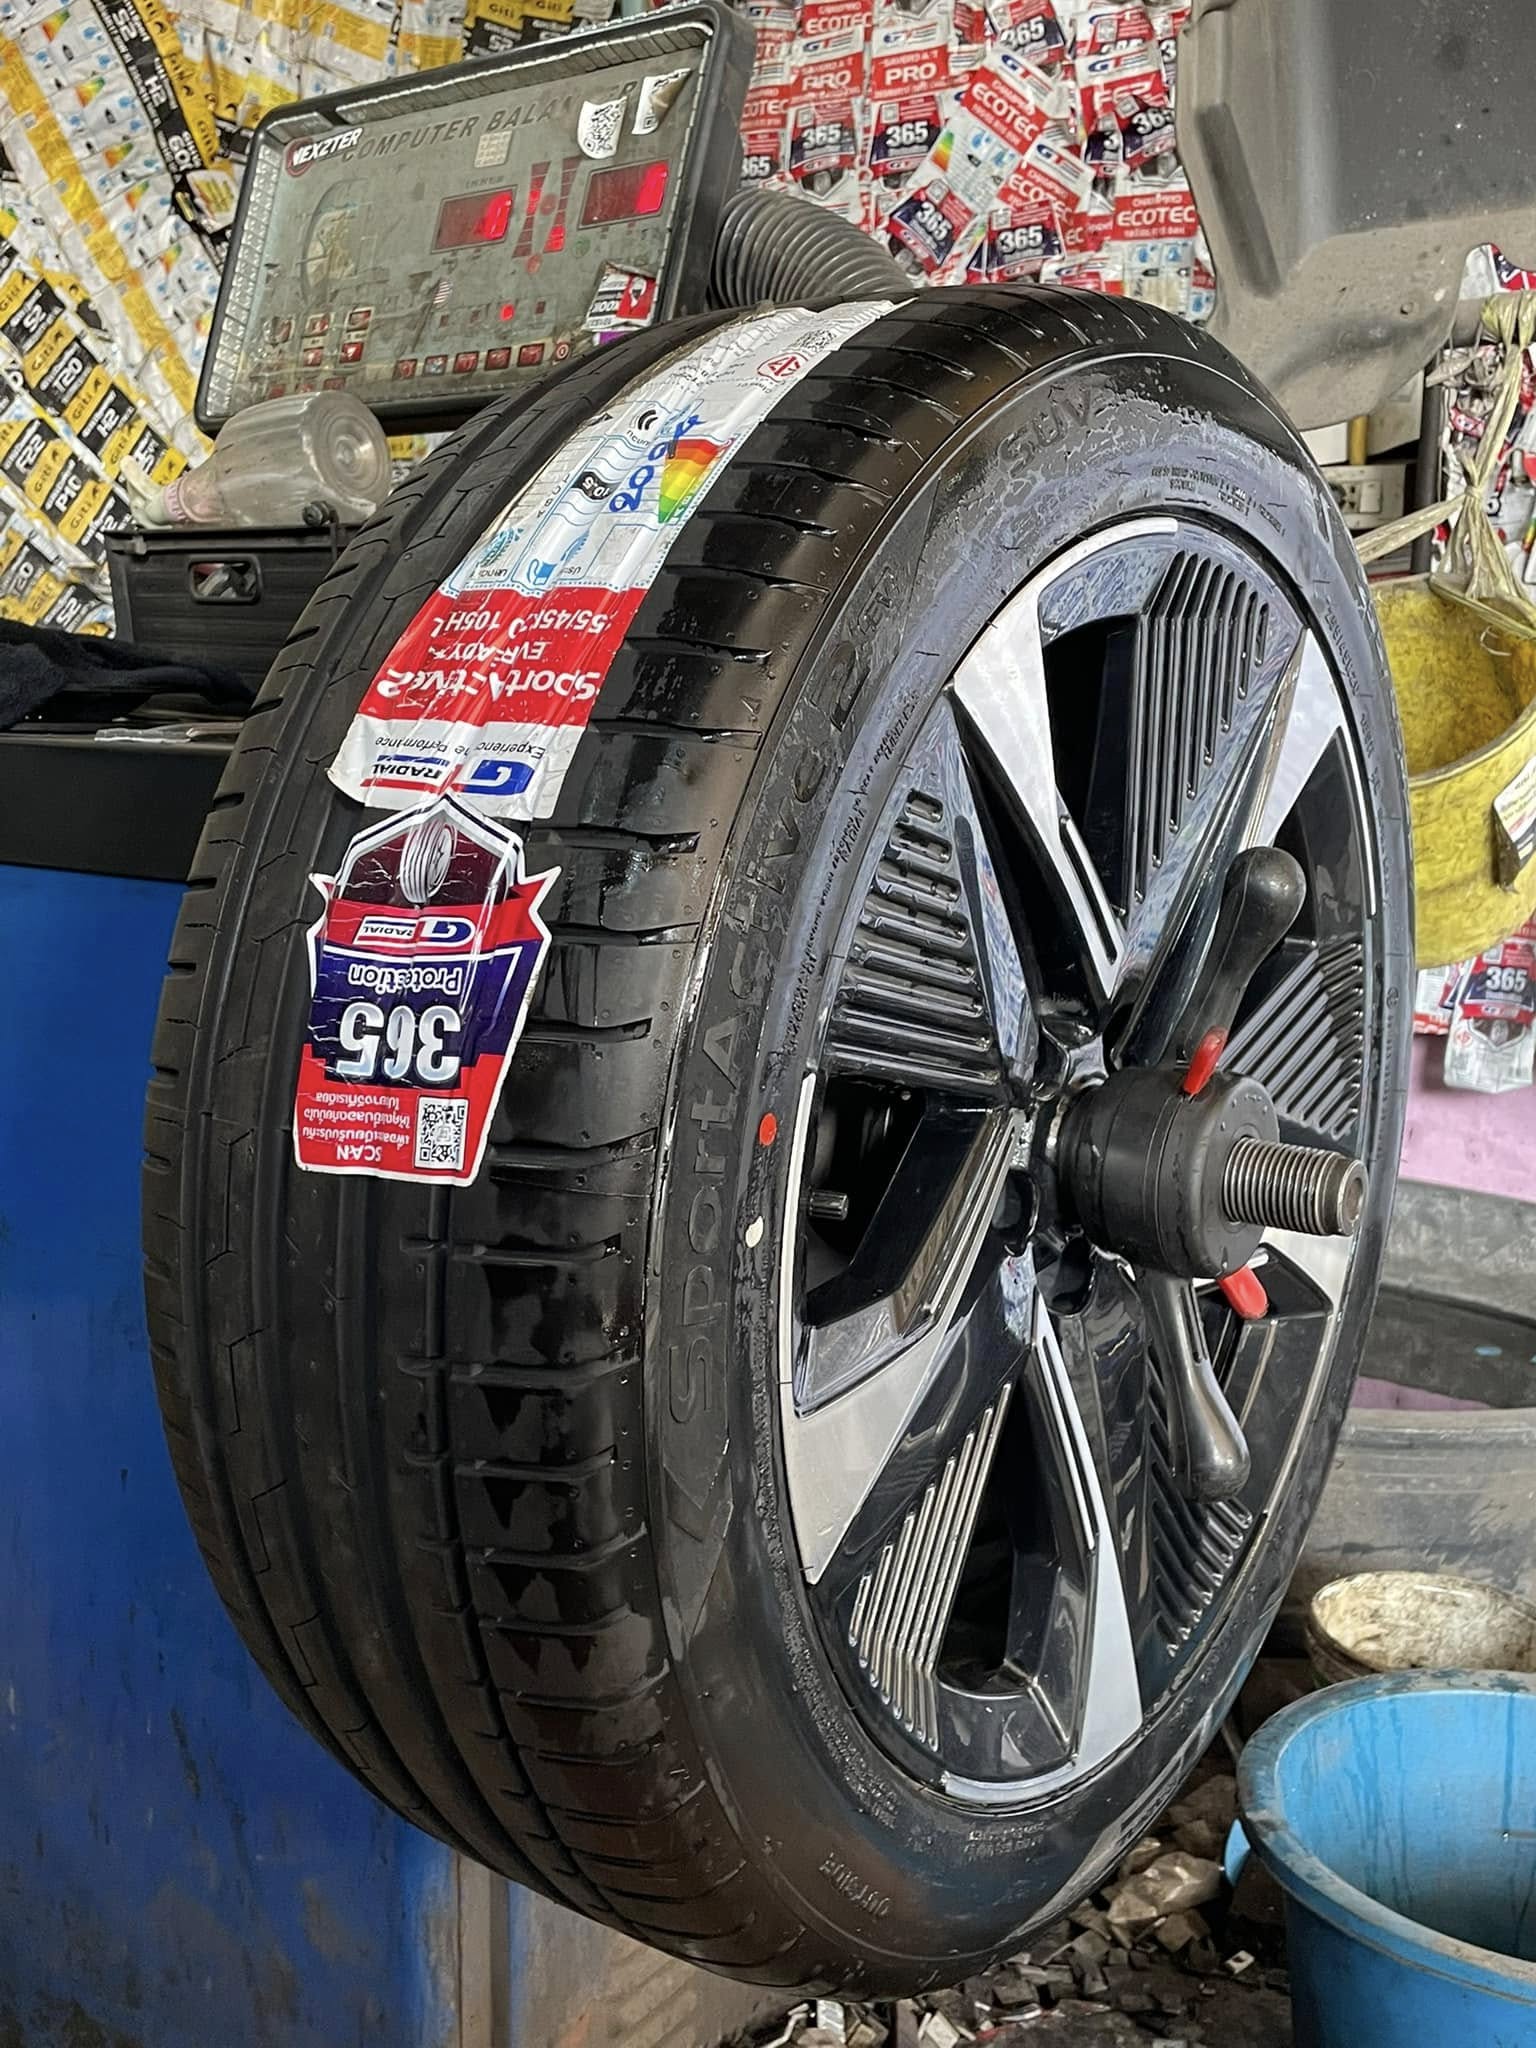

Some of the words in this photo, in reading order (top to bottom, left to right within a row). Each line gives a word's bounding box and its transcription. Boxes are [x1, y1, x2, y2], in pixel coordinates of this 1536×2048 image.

[1001, 15, 1045, 49] 365
[885, 62, 937, 86] PRO
[972, 82, 1039, 141] ECOTEC
[342, 116, 480, 162] COMPUTER
[802, 123, 842, 150] 365
[886, 121, 928, 147] 365
[916, 202, 952, 241] 365
[1117, 206, 1195, 226] ECOTEC
[999, 226, 1043, 253] 365
[51, 357, 83, 391] T20
[97, 407, 120, 439] H2
[55, 475, 82, 512] P10
[371, 764, 441, 781] RADIAL
[346, 962, 465, 996] Protection
[1486, 966, 1528, 992] 365
[336, 1001, 461, 1082] 365
[336, 1144, 382, 1162] SCAN
